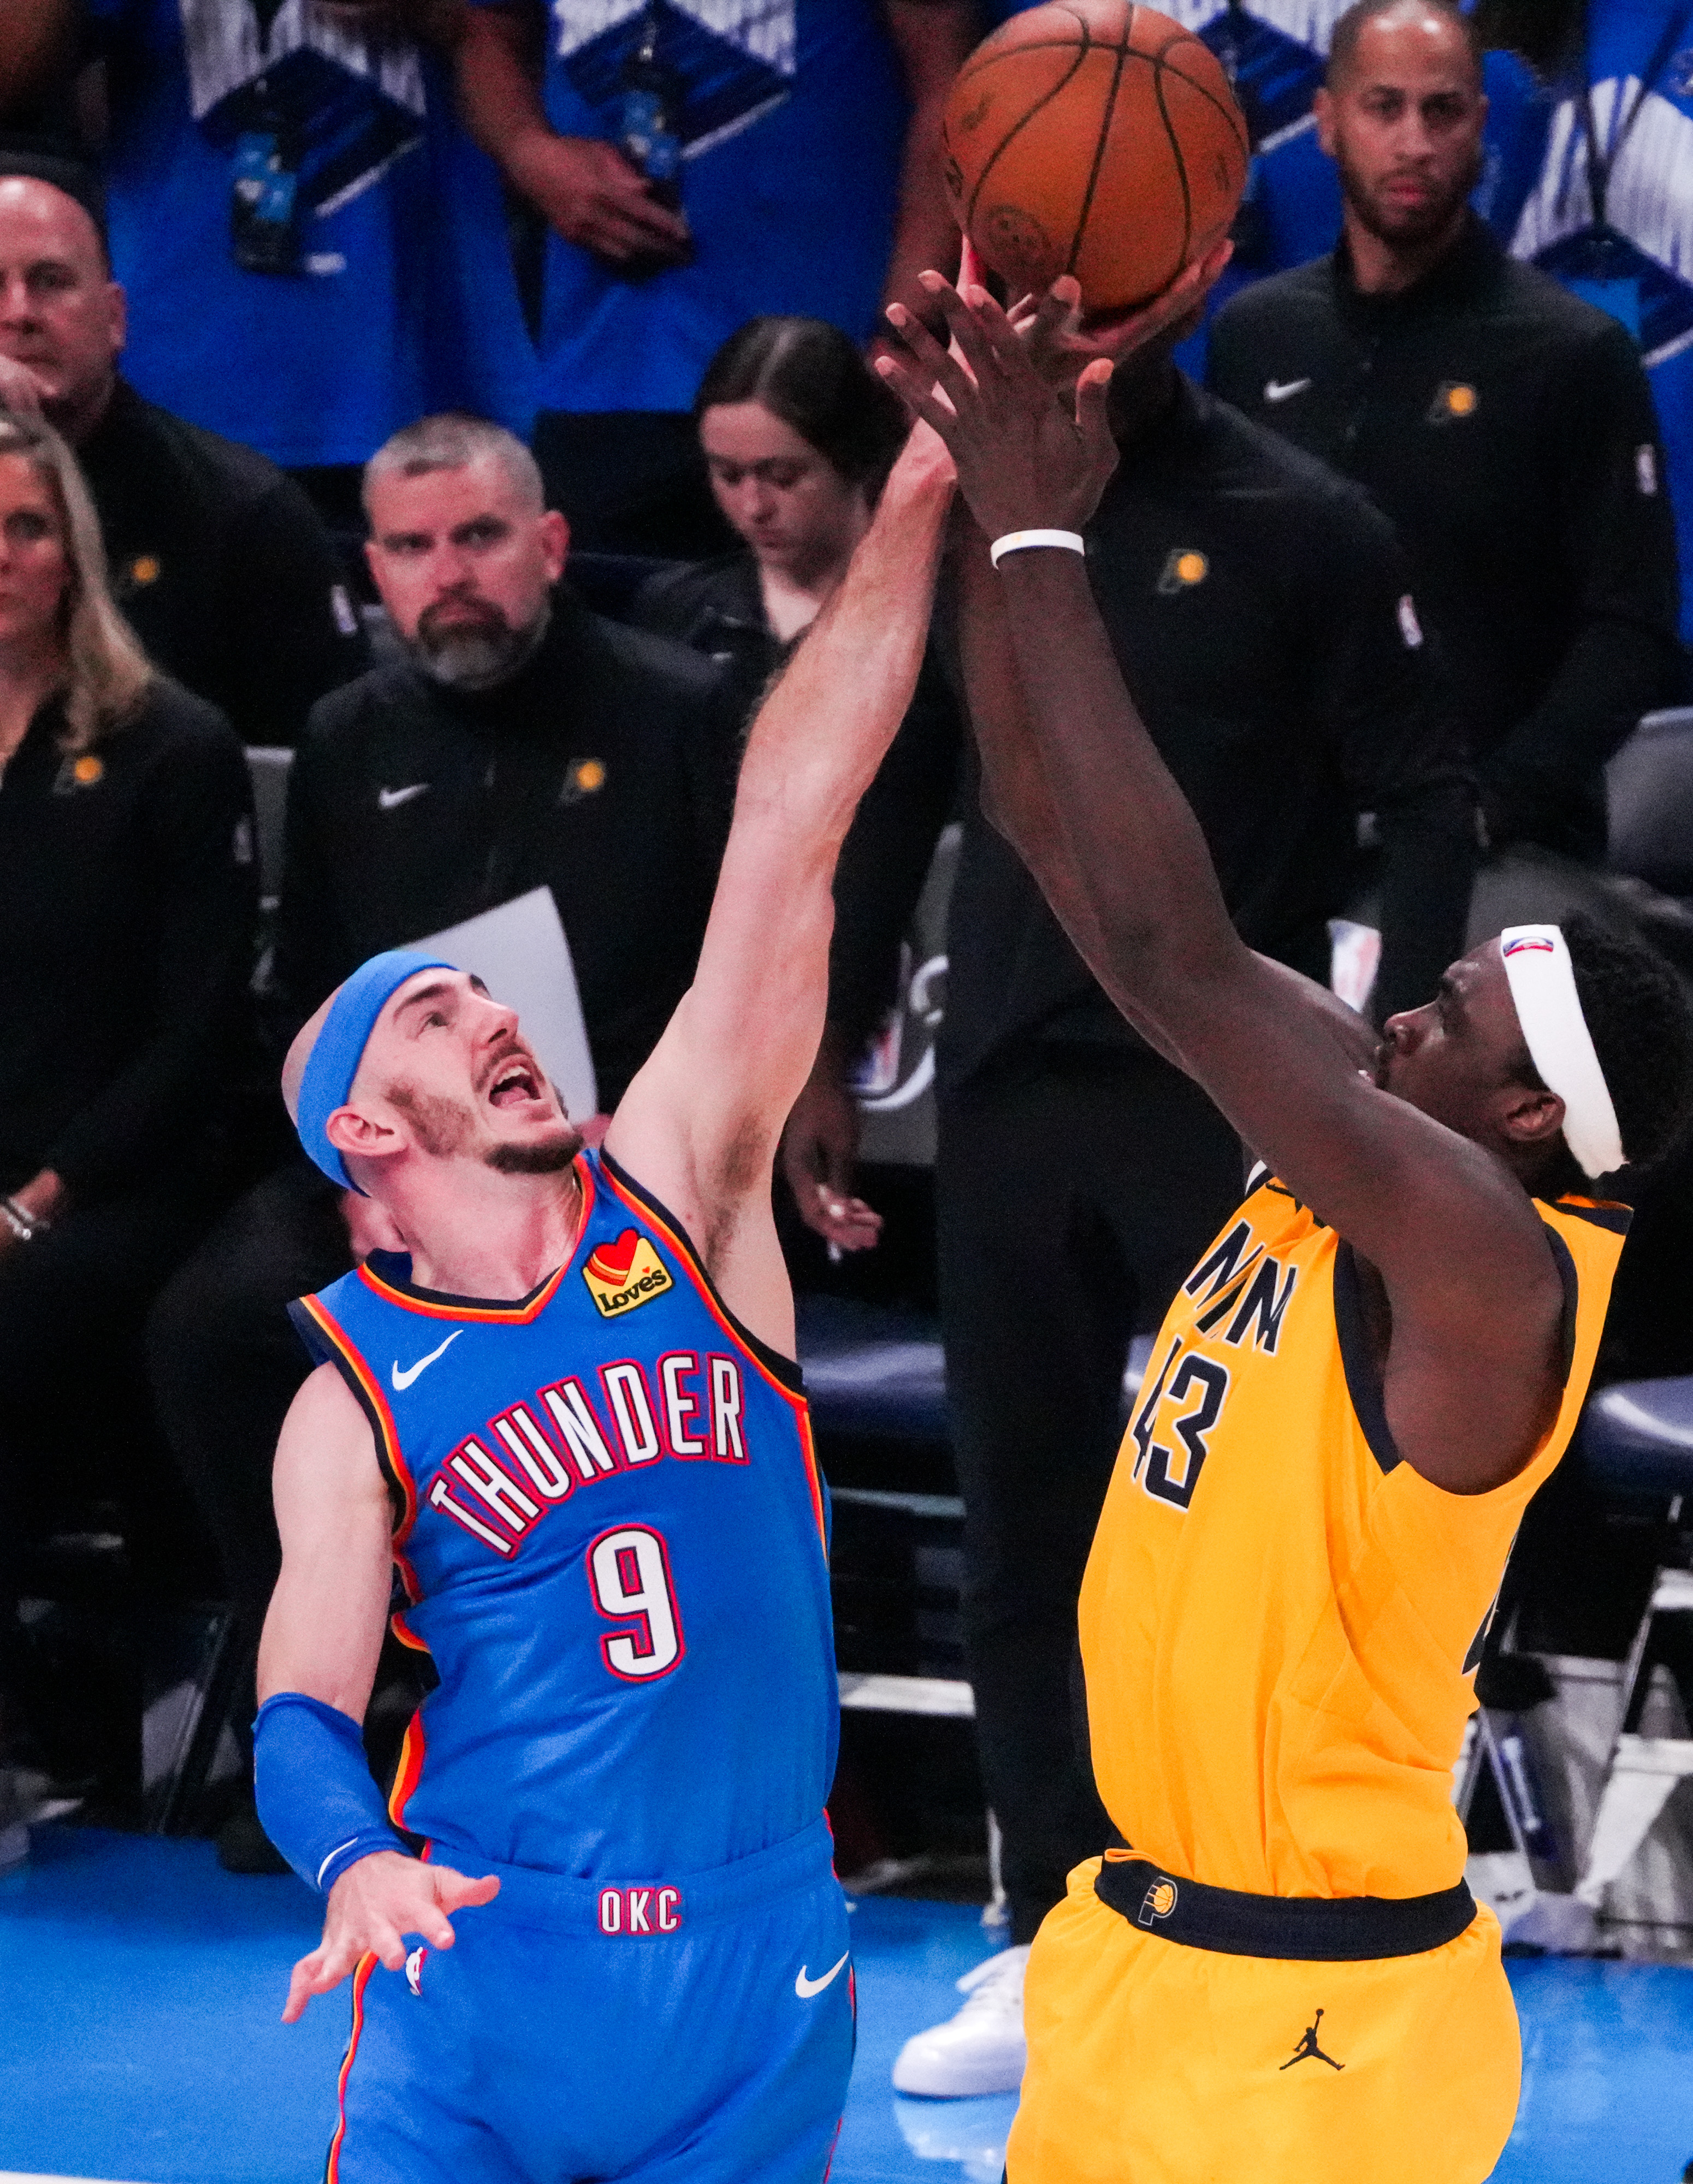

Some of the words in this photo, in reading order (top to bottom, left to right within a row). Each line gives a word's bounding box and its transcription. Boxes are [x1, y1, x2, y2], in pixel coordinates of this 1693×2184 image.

[428, 1351, 749, 1558] THUNDER
[587, 1523, 685, 1682] 9
[599, 1886, 682, 1935] OKC
